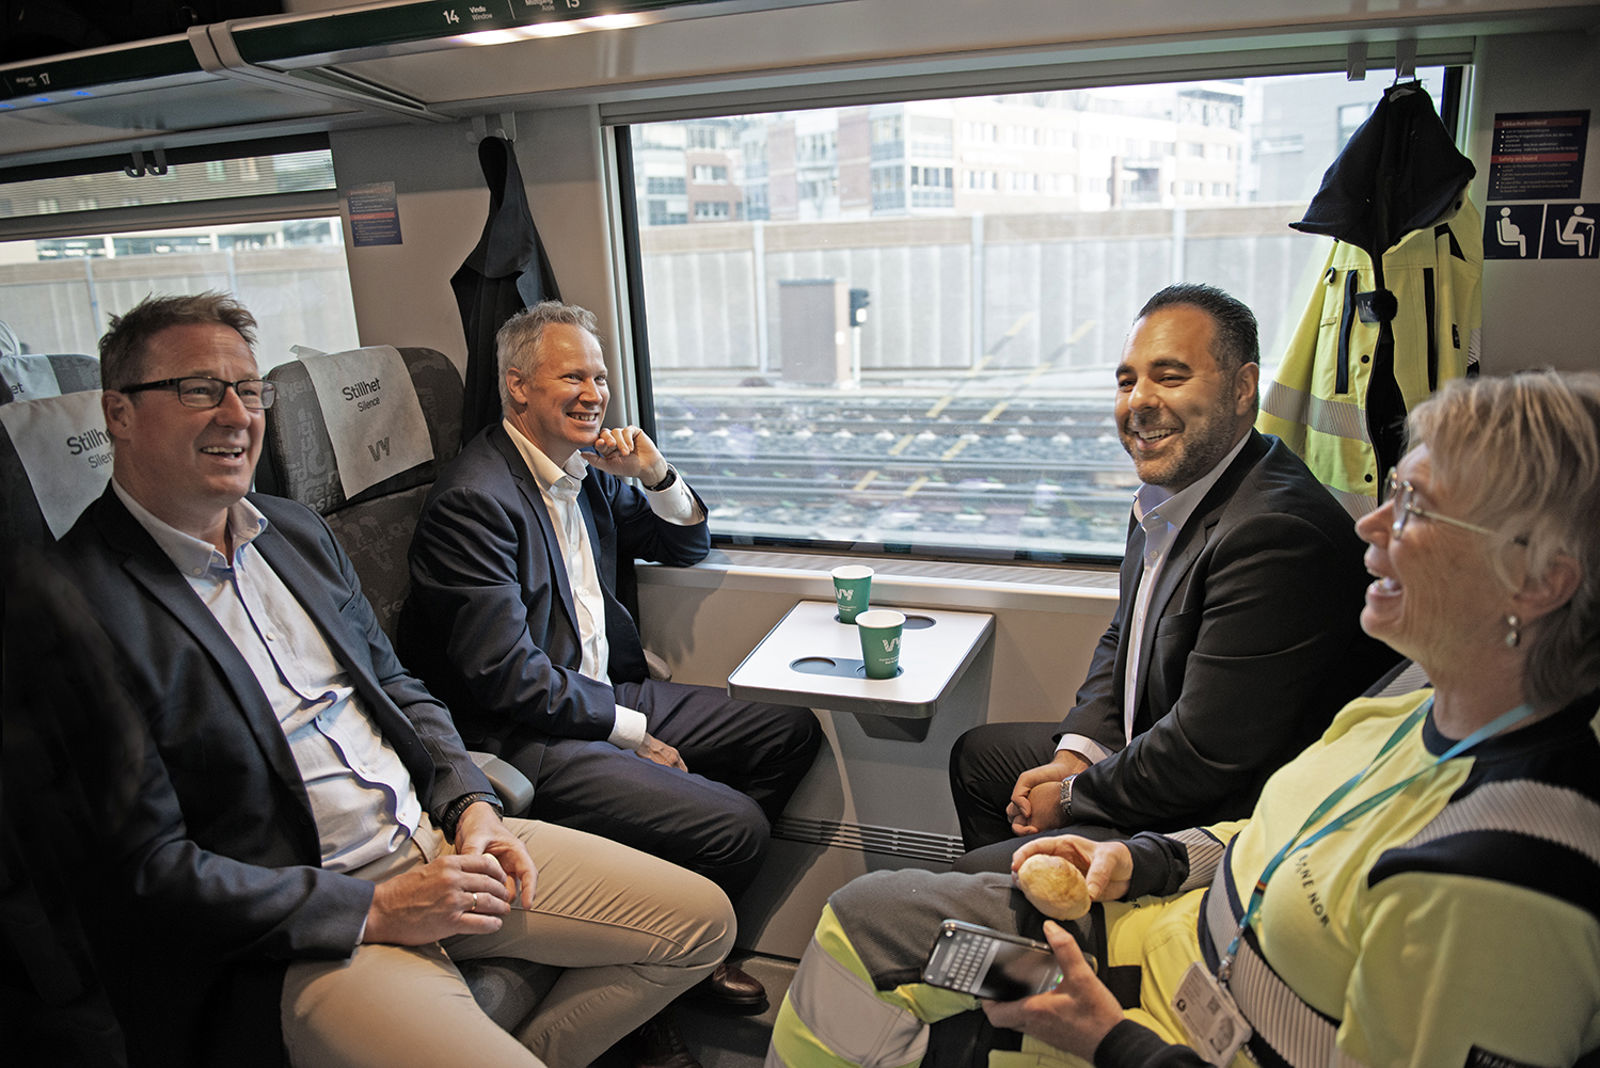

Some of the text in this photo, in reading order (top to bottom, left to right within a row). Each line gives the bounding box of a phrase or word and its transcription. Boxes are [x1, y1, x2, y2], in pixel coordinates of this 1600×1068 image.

[443, 10, 460, 25] 14
[40, 73, 50, 85] 17
[341, 377, 382, 402] Stillhet
[356, 396, 381, 413] Silence
[66, 428, 112, 456] Stillh
